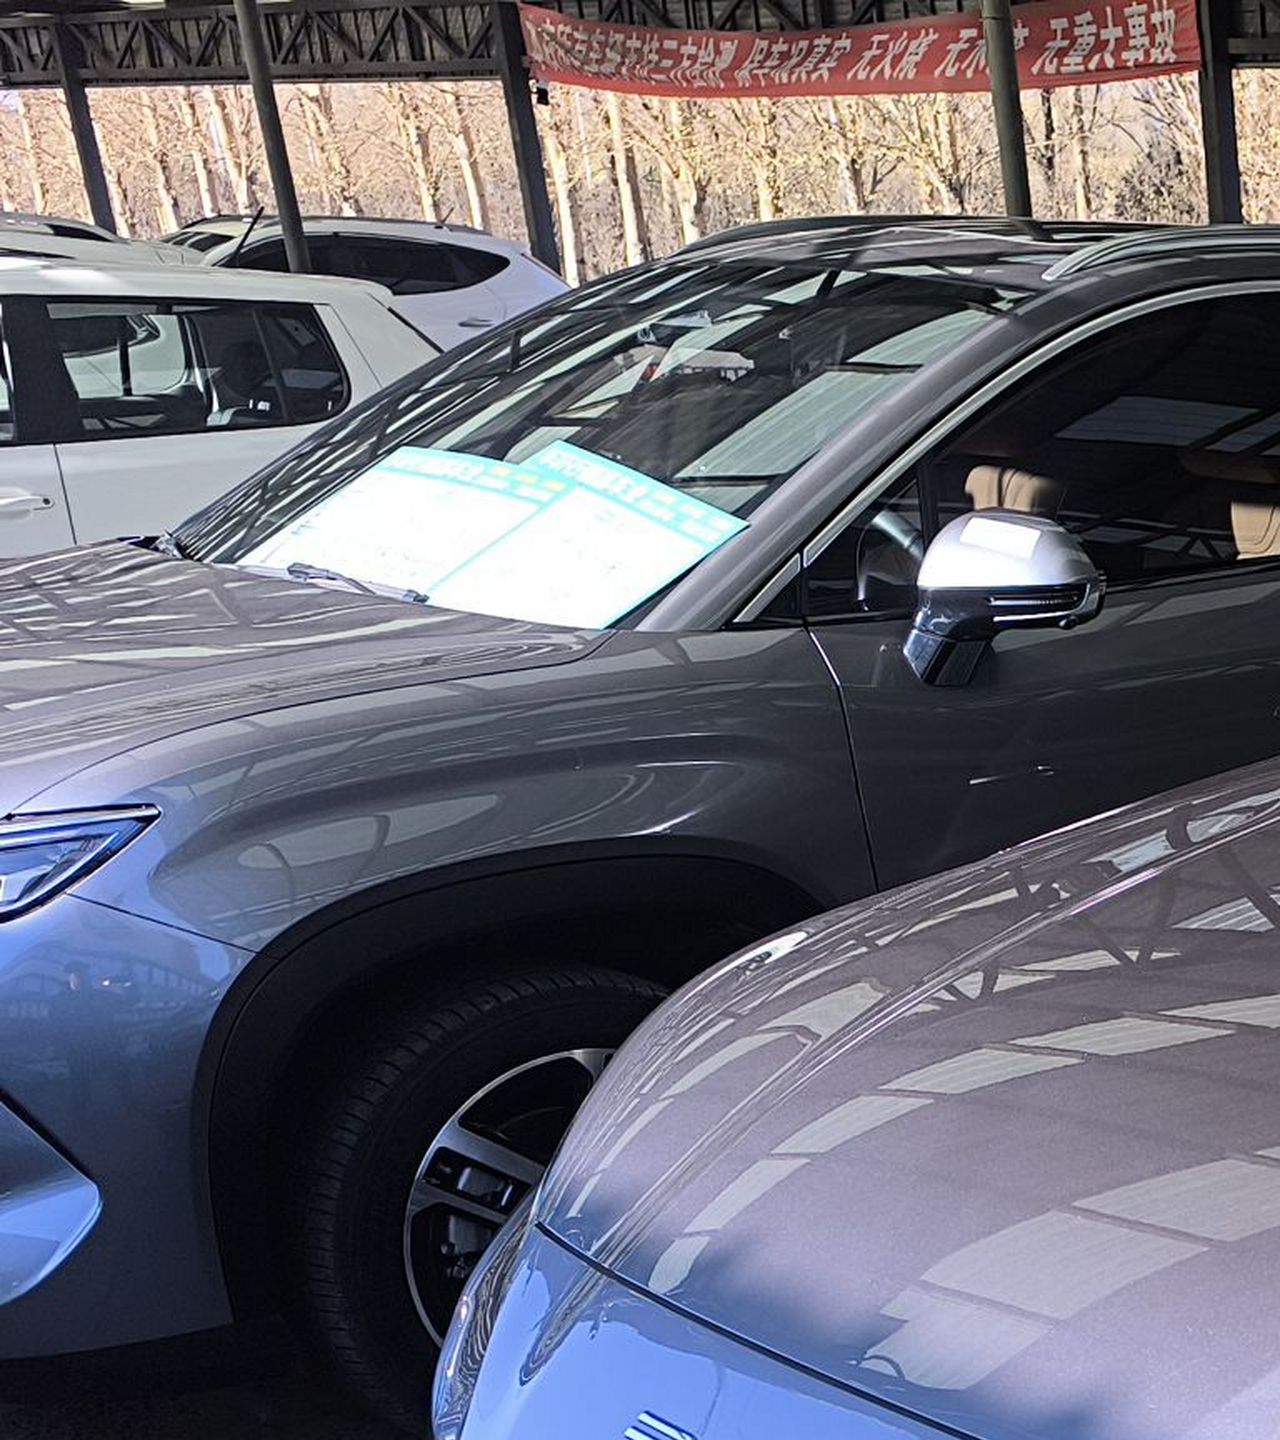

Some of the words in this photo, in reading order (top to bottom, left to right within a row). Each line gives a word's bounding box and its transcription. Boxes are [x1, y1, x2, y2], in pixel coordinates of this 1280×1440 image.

[934, 19, 1029, 78] 无水
[1031, 0, 1177, 74] 无重大事故
